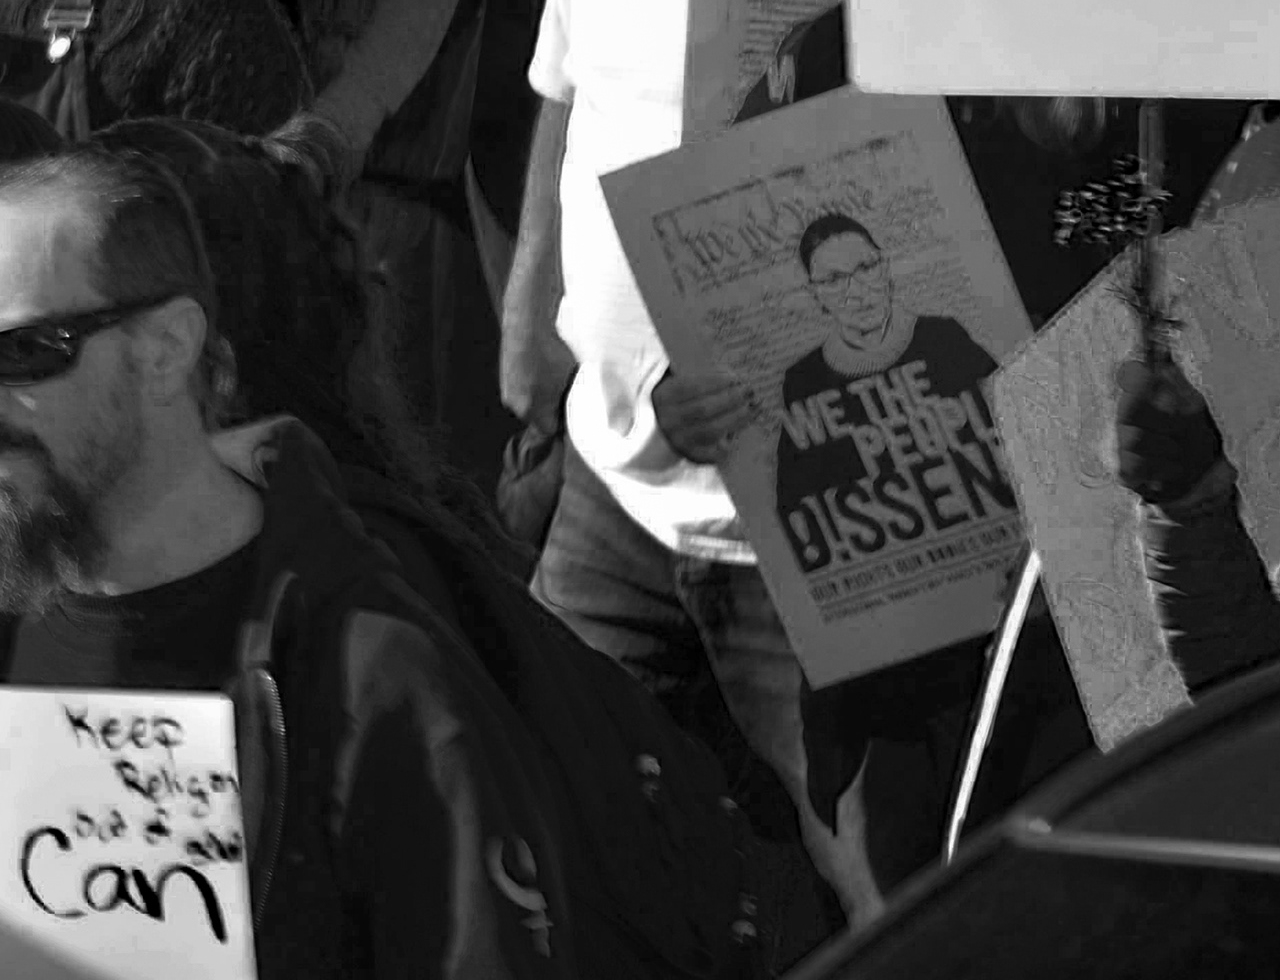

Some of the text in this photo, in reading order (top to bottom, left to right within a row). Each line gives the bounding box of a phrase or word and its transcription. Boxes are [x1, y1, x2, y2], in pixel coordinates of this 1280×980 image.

[778, 358, 932, 452] WE THE
[853, 390, 998, 480] PEOPL
[788, 445, 1022, 573] DISSEN
[20, 825, 228, 945] Can
